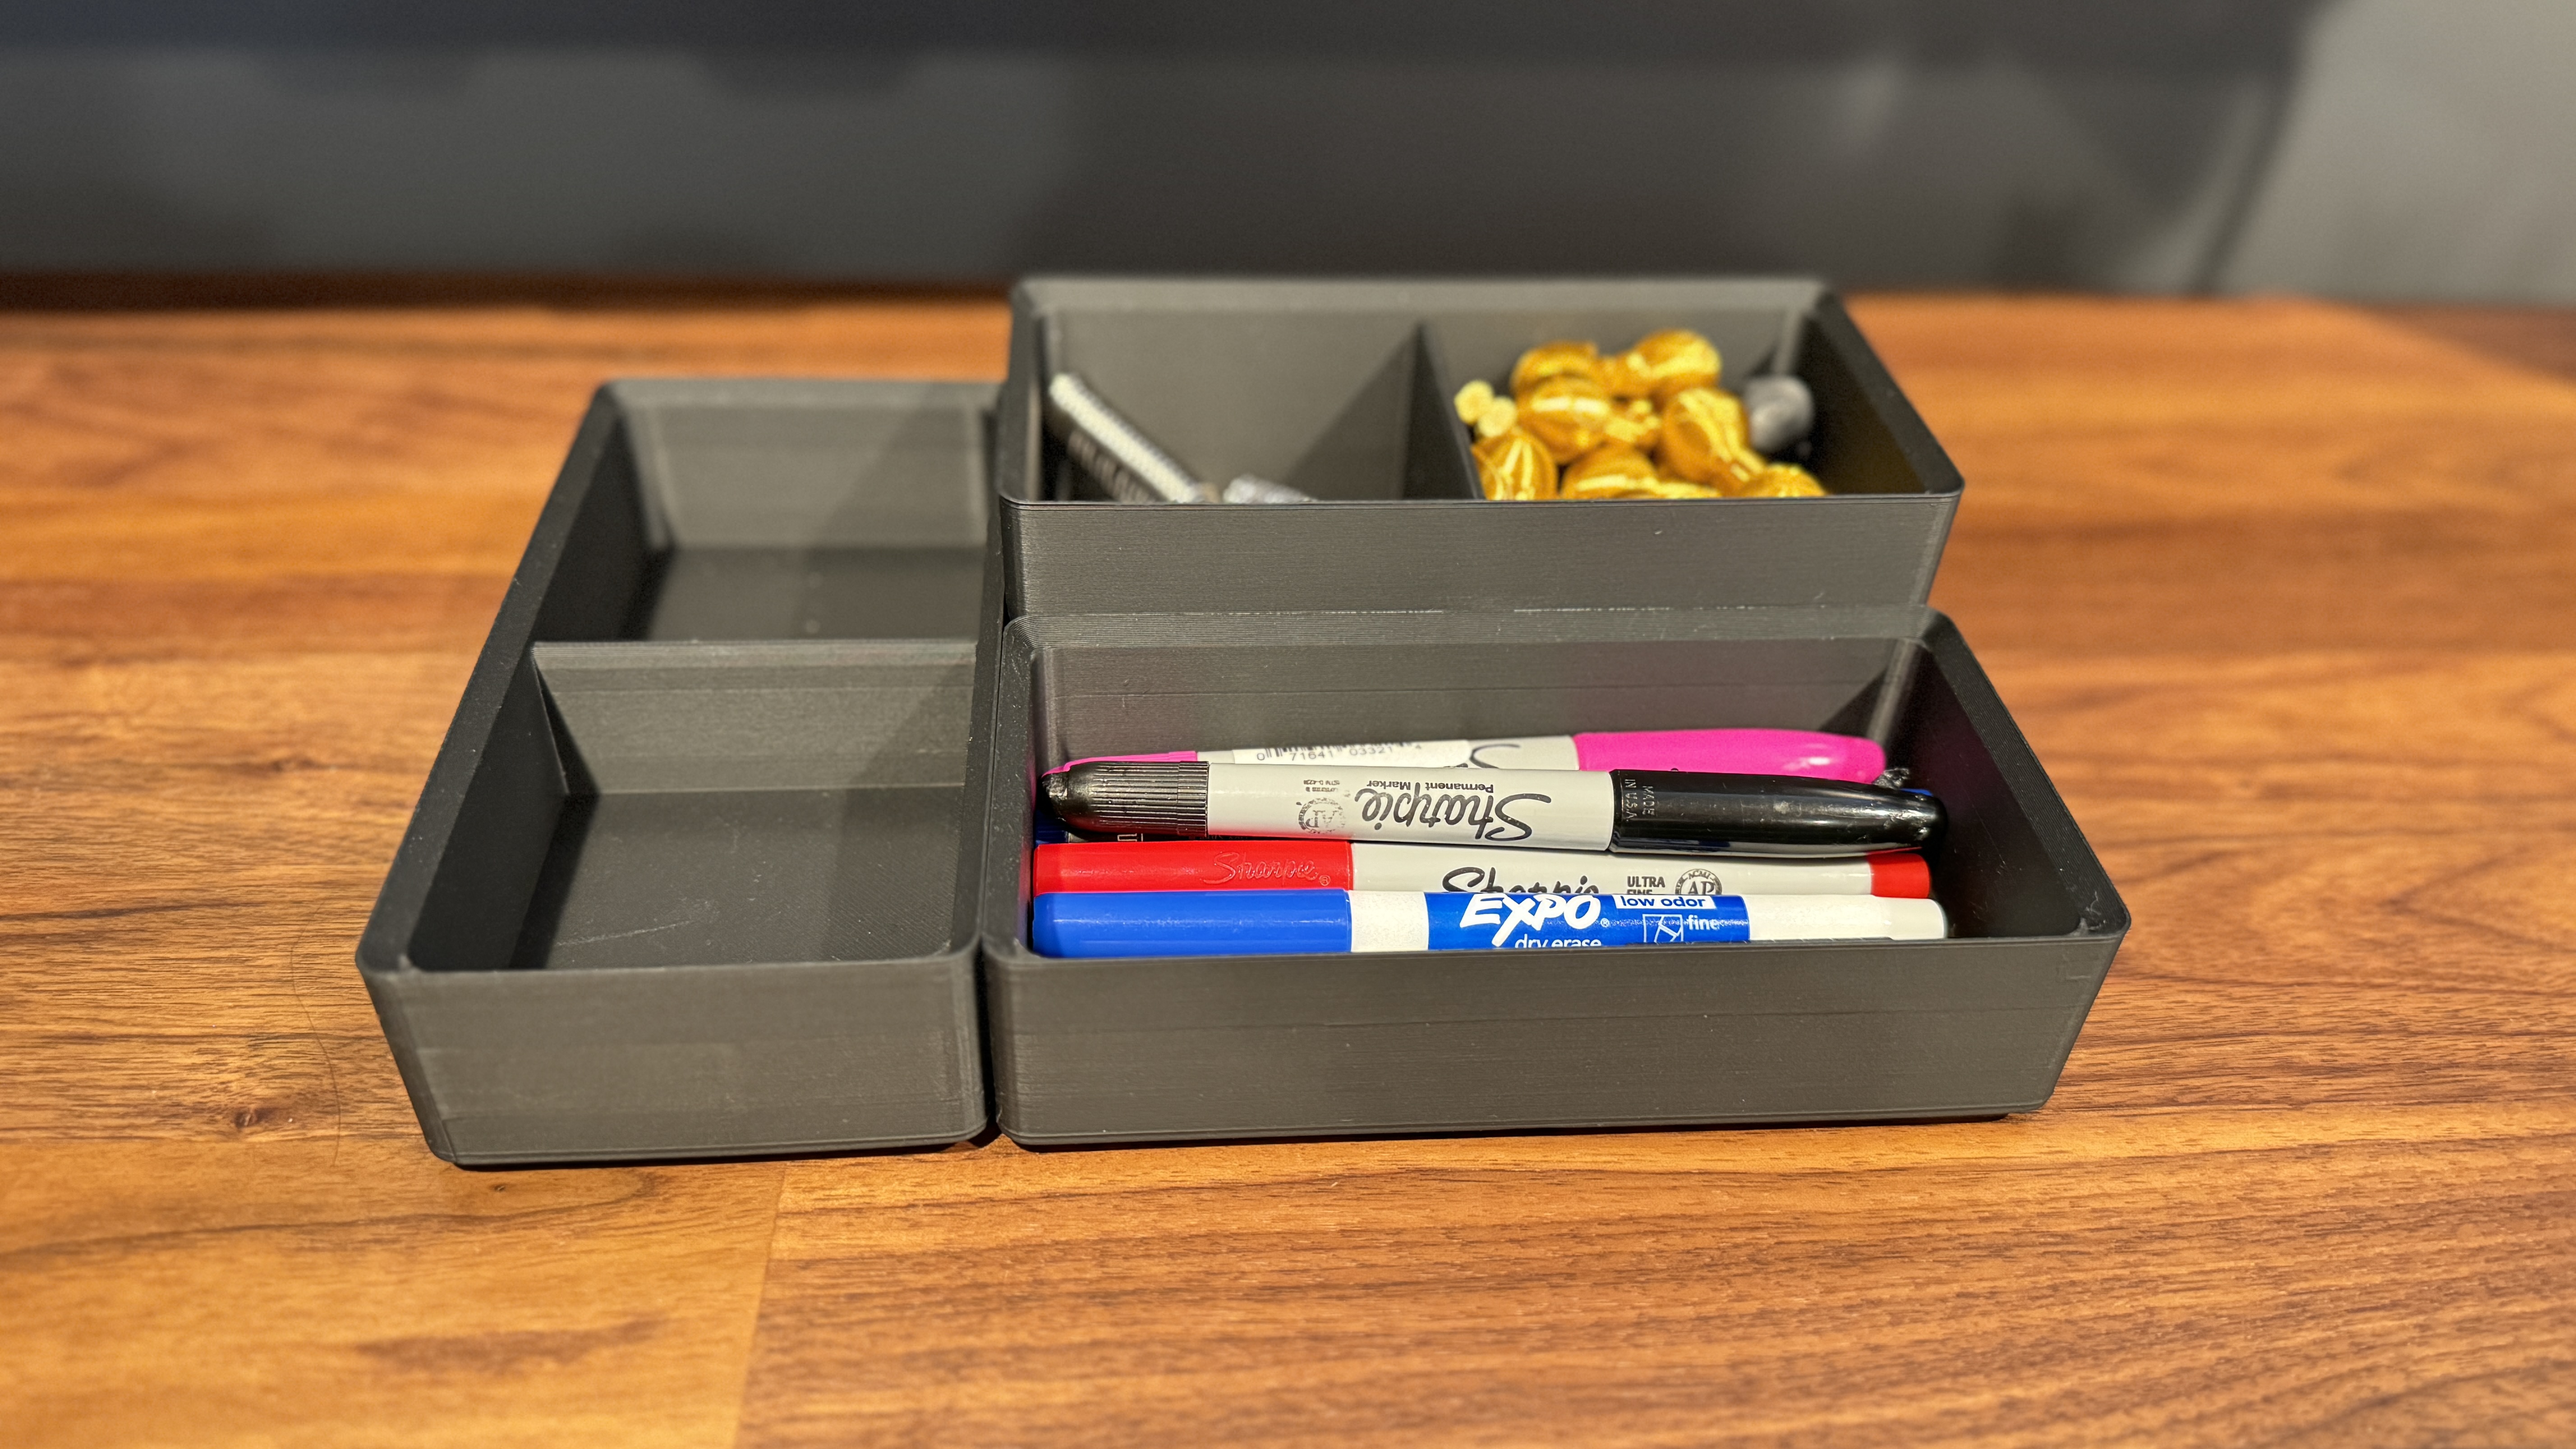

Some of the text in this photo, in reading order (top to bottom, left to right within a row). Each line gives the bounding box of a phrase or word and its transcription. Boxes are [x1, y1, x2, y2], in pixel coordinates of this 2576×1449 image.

[1256, 752, 1265, 761] 0
[1288, 750, 1334, 761] 71641
[1349, 746, 1393, 756] 03321
[1366, 780, 1494, 793] Permanent Marker
[1624, 779, 1637, 788] IN
[1642, 786, 1655, 815] MADE
[1354, 782, 1551, 841] Sharpie
[1203, 849, 1320, 885] Sharpie
[1627, 876, 1665, 888] ULTRA
[1688, 880, 1715, 895] AP
[1620, 895, 1706, 907] low odor
[1459, 893, 1601, 947] EXPO
[1686, 914, 1720, 931] fine
